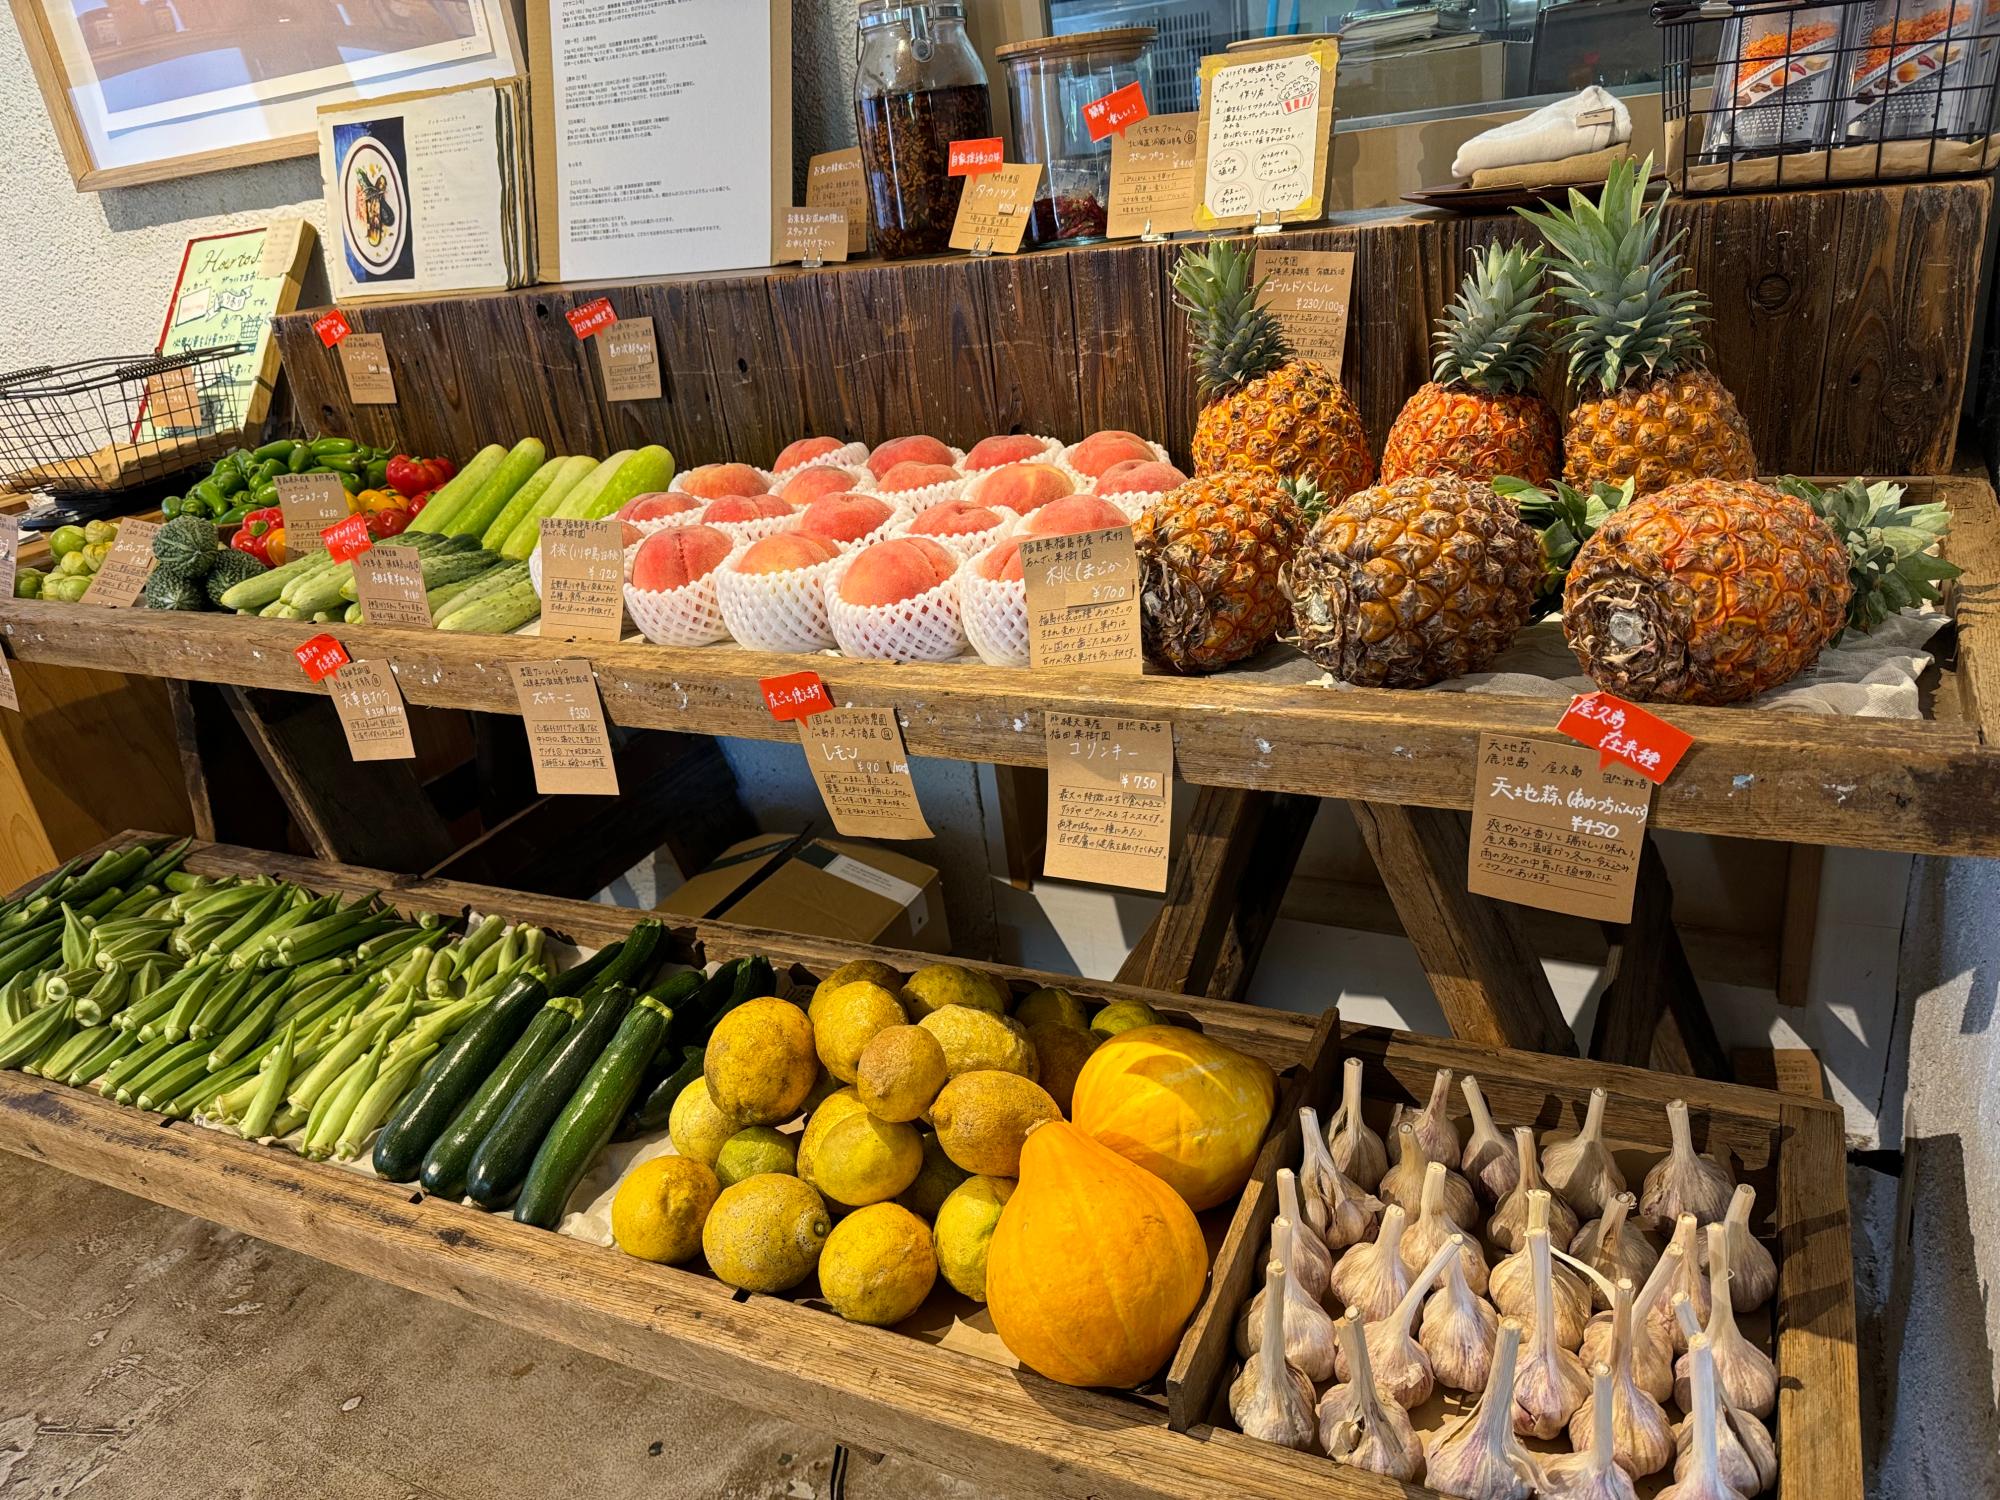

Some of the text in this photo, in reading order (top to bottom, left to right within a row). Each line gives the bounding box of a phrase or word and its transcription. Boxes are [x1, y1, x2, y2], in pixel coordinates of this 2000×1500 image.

[1265, 278, 1334, 293] ゴールドバレル
[1296, 297, 1345, 317] ¥230/100g
[1046, 558, 1131, 586] 桃(まどか)
[1092, 585, 1125, 602] ¥700
[341, 689, 391, 709] 天草白オクラ
[532, 691, 576, 706] ズッキーニ
[767, 684, 822, 710] 皮ごと使えます
[1570, 698, 1627, 729] 屋久島
[1049, 730, 1111, 742] 福田果樹園
[822, 743, 858, 761] レモン
[1069, 742, 1140, 761] コリンキー
[1598, 730, 1662, 771] 在来種
[857, 760, 880, 773] ¥90
[1484, 753, 1529, 769] 鹿児島
[1541, 761, 1583, 778] 屋久島
[1120, 773, 1158, 790] ¥750
[1571, 815, 1620, 838] ¥450
